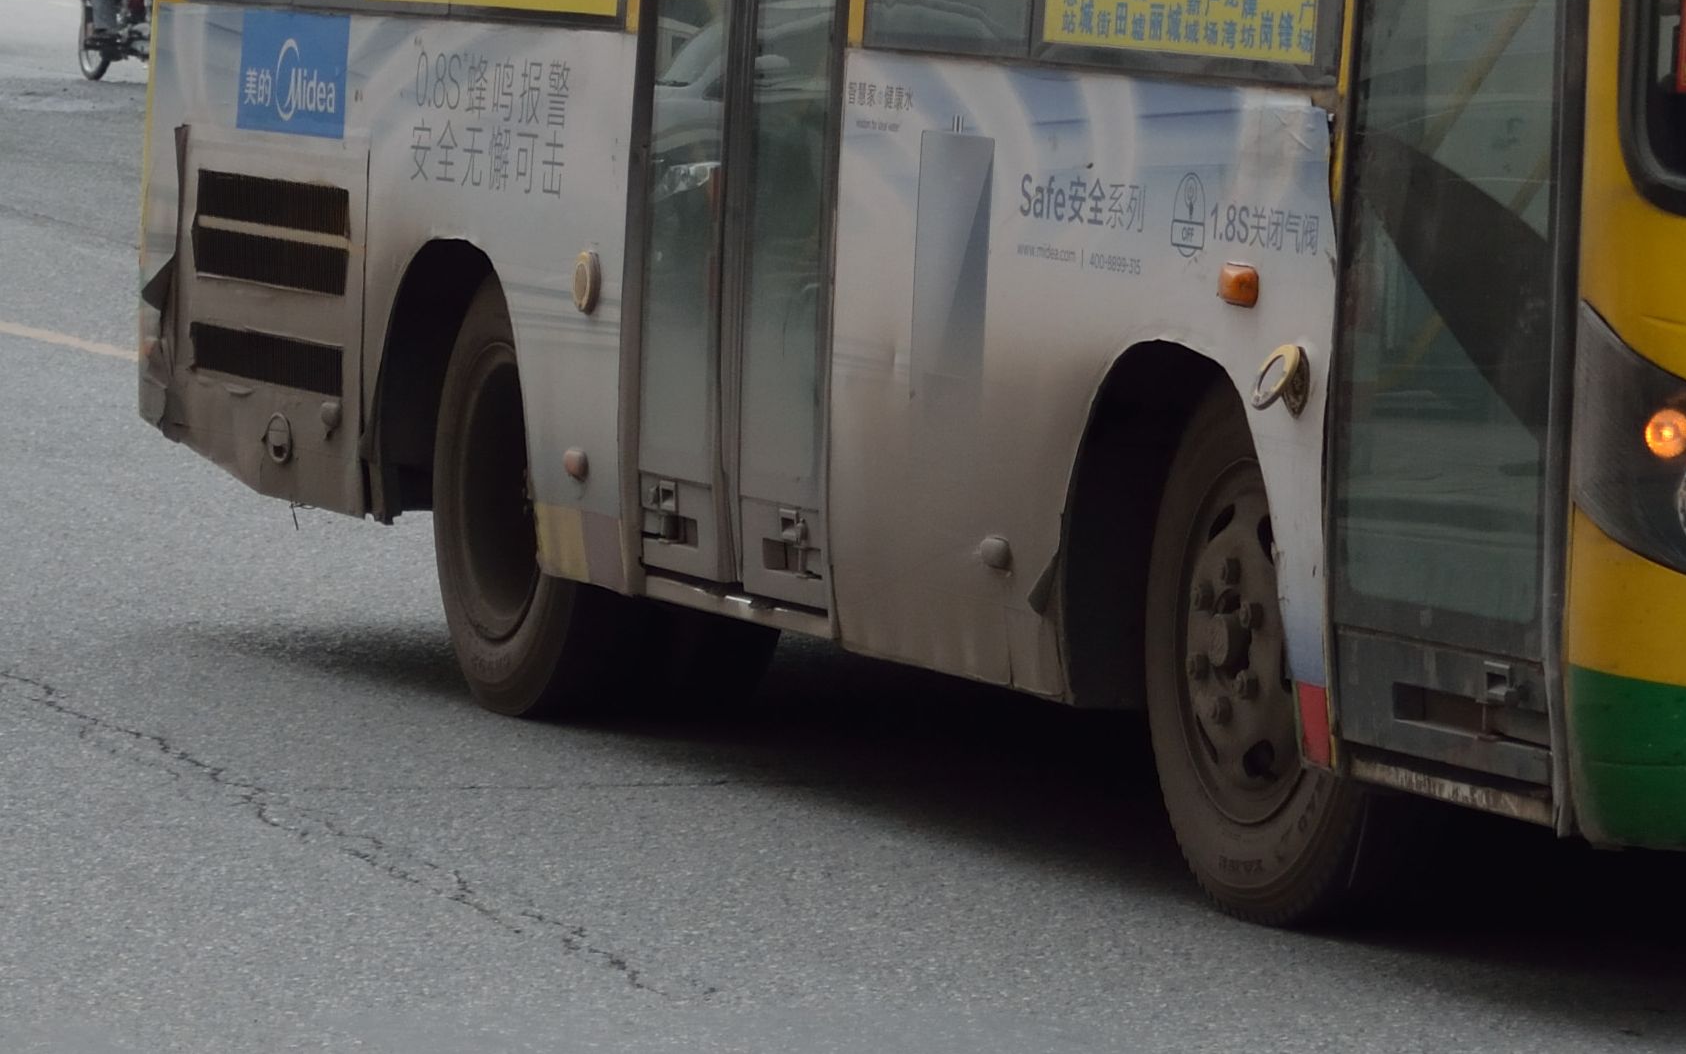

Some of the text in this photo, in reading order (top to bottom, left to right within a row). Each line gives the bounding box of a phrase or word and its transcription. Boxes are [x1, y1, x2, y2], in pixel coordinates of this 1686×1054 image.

[244, 49, 336, 120] 美的 Midea
[410, 118, 566, 199] 安全无懈可击
[1020, 173, 1147, 233] Safe安全系列
[1181, 226, 1195, 242] OFF
